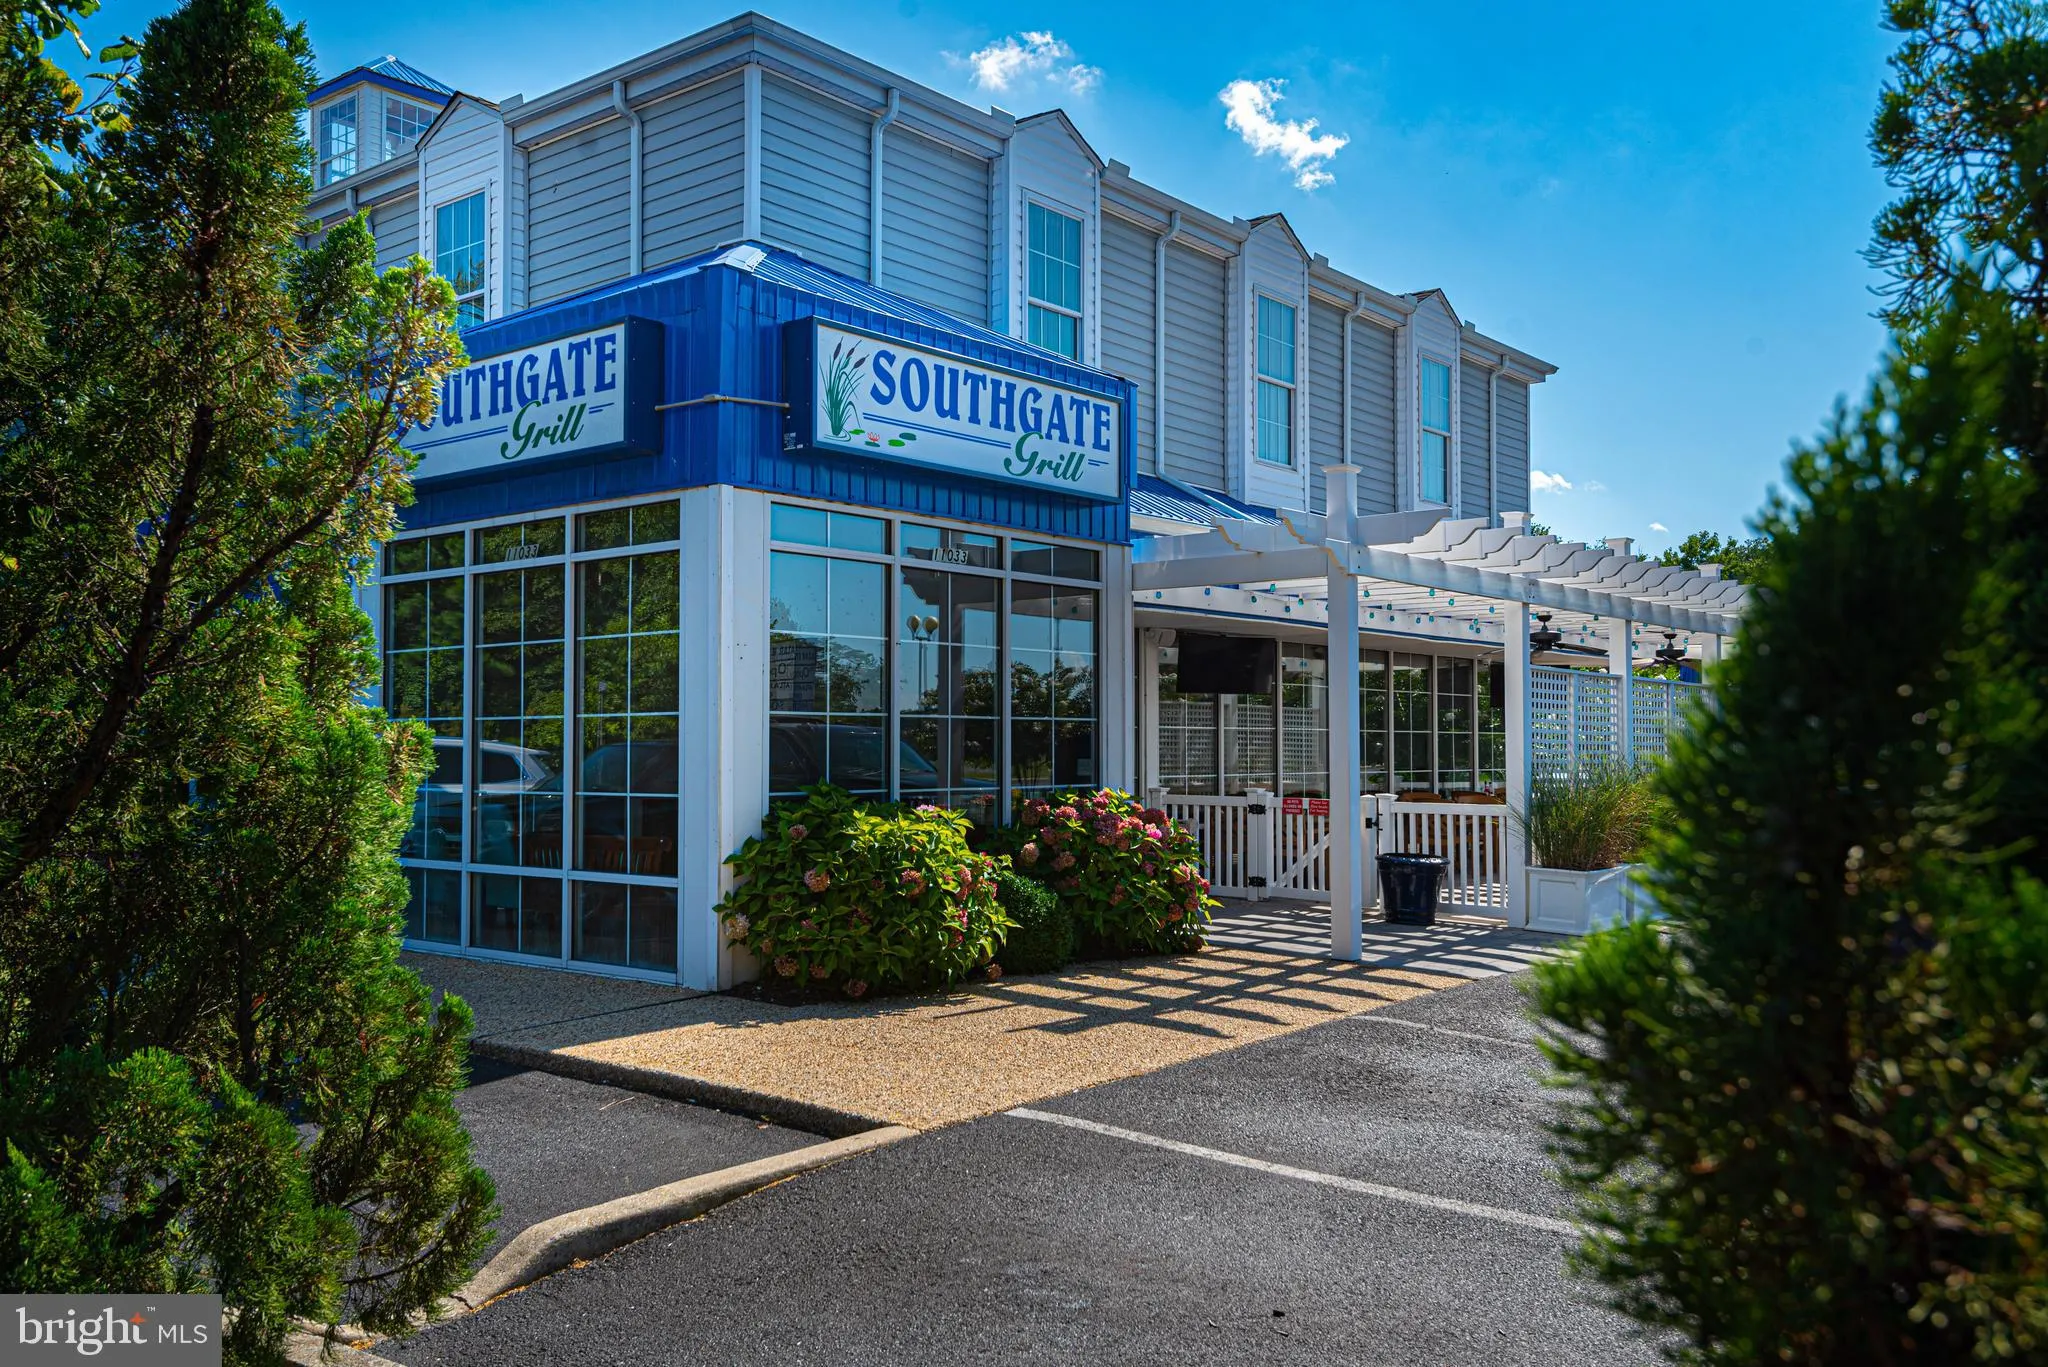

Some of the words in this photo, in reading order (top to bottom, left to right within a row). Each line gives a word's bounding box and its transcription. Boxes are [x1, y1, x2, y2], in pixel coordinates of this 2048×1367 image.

[869, 349, 1111, 453] SOUTHGATE
[500, 400, 587, 460] Grill
[1003, 431, 1086, 482] Grill
[507, 545, 538, 561] 11033
[934, 548, 967, 564] 11033
